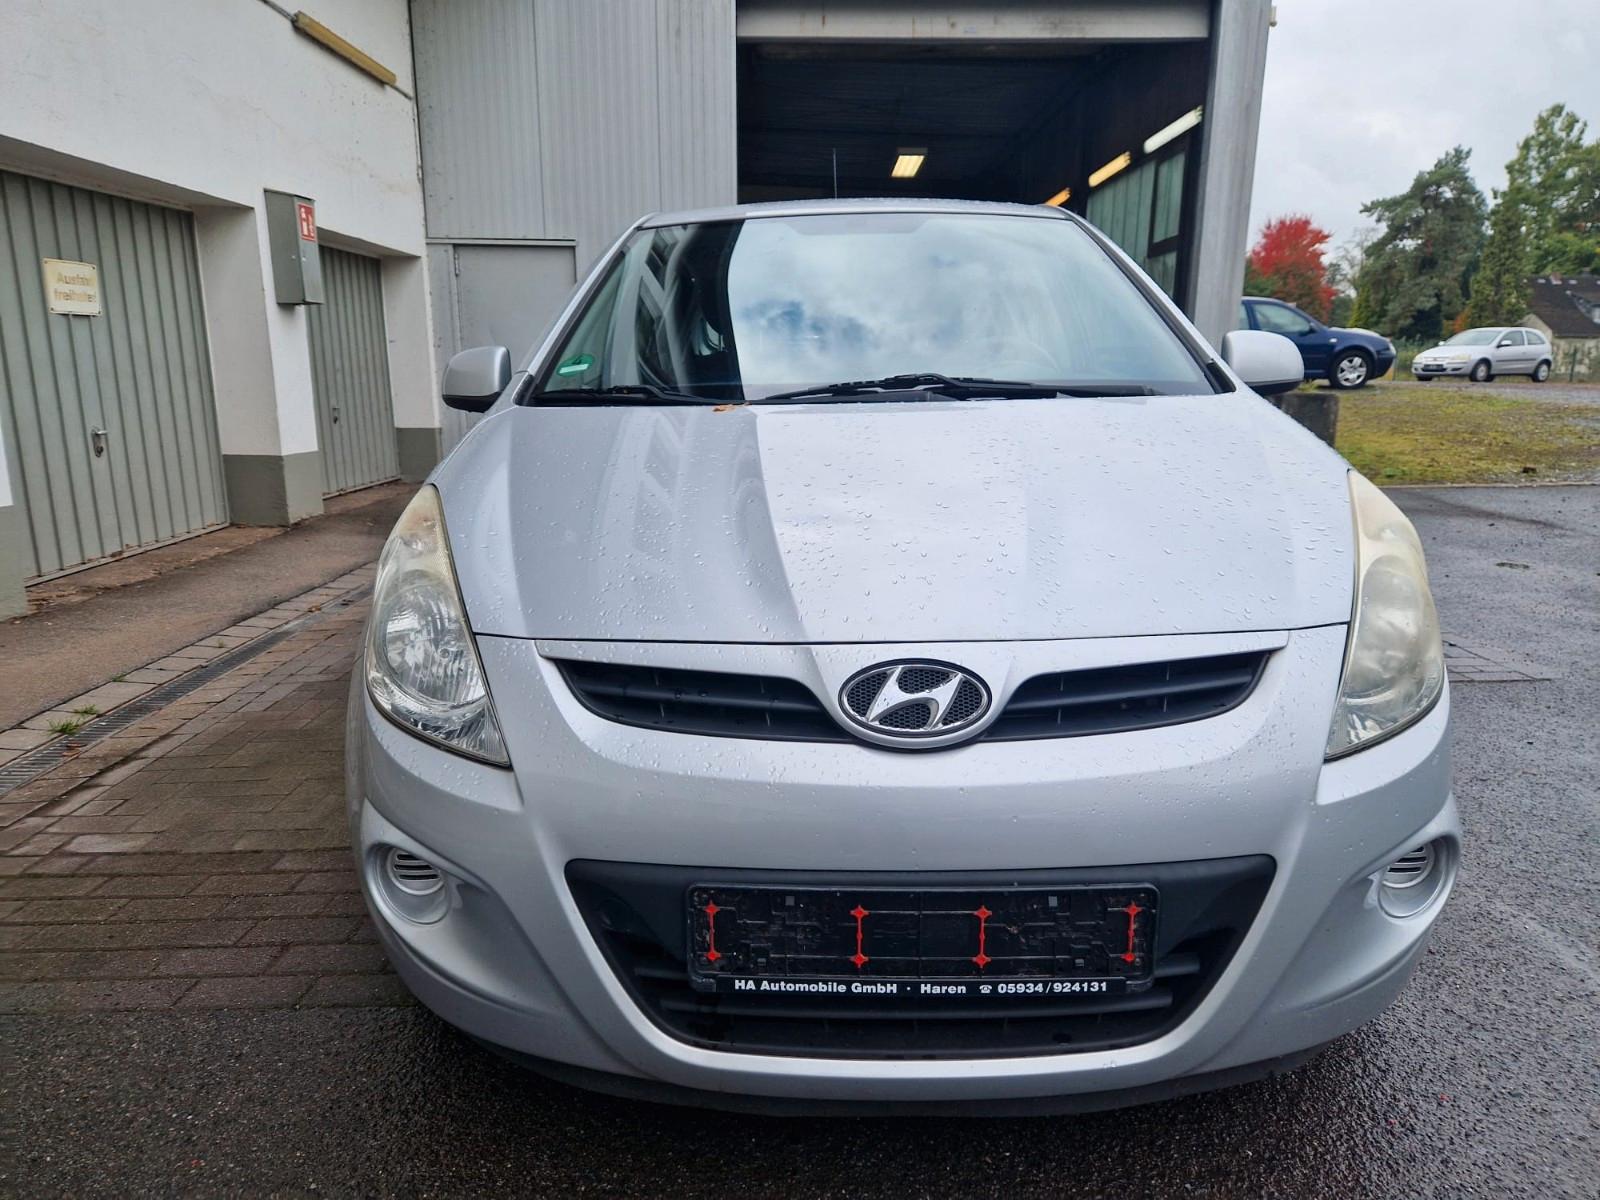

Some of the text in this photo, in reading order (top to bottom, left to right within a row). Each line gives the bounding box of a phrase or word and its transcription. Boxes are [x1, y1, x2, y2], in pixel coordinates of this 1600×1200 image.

[57, 272, 95, 287] Ausfah
[734, 979, 1107, 994] HA Automobile GmbH Haren 05934/924131
